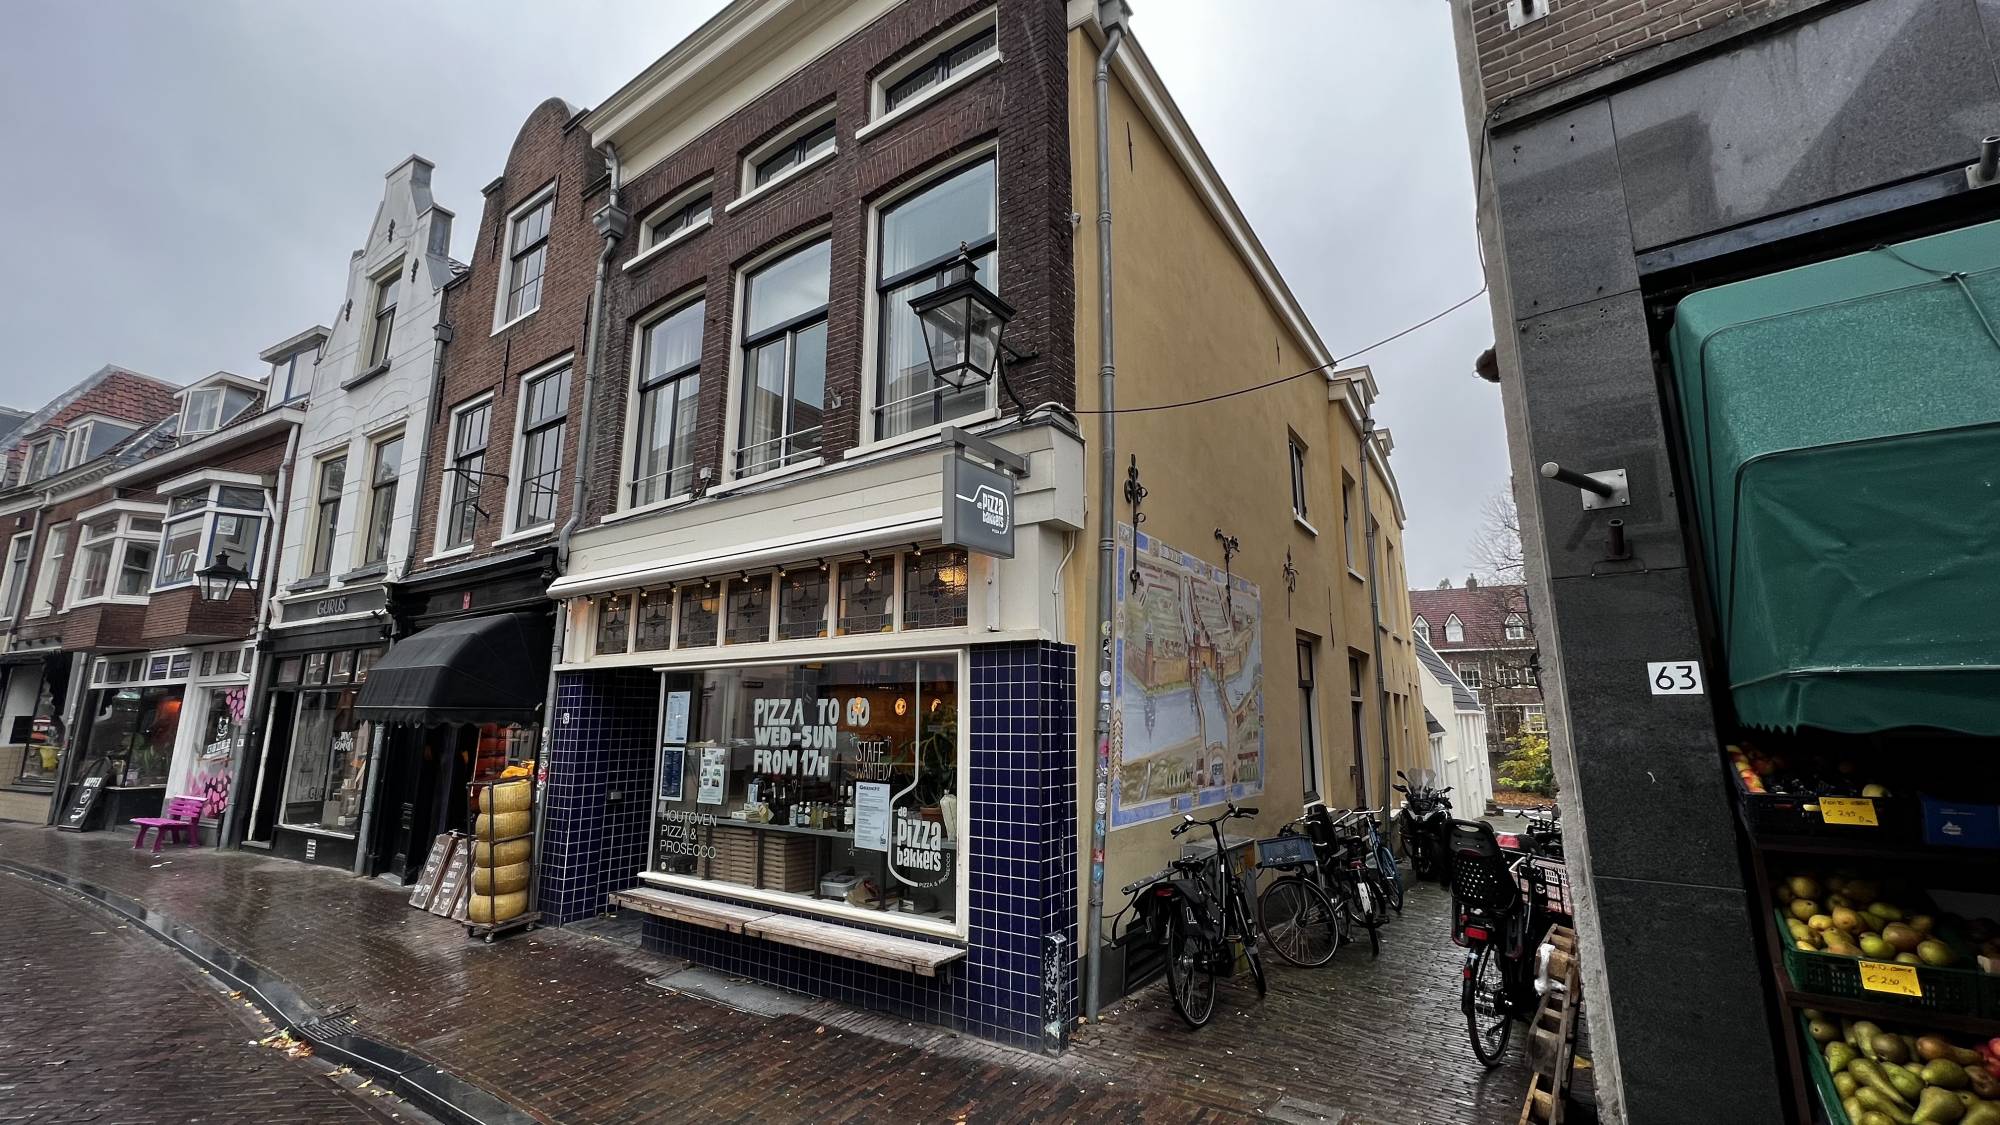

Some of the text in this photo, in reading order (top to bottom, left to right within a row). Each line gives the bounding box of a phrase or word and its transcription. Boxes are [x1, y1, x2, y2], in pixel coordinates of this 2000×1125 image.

[317, 597, 346, 615] GURUS
[1655, 665, 1697, 691] 63
[754, 697, 870, 726] PIZZA TO GO
[754, 725, 837, 749] WED-SUN
[753, 749, 798, 775] FROM
[855, 741, 885, 763] STAFF
[662, 810, 717, 827] HOUTOVEN
[897, 806, 907, 817] de
[660, 824, 697, 840] PIZZA &
[897, 818, 941, 851] pizza
[660, 839, 716, 858] PROSECCO
[896, 848, 942, 872] bakkers
